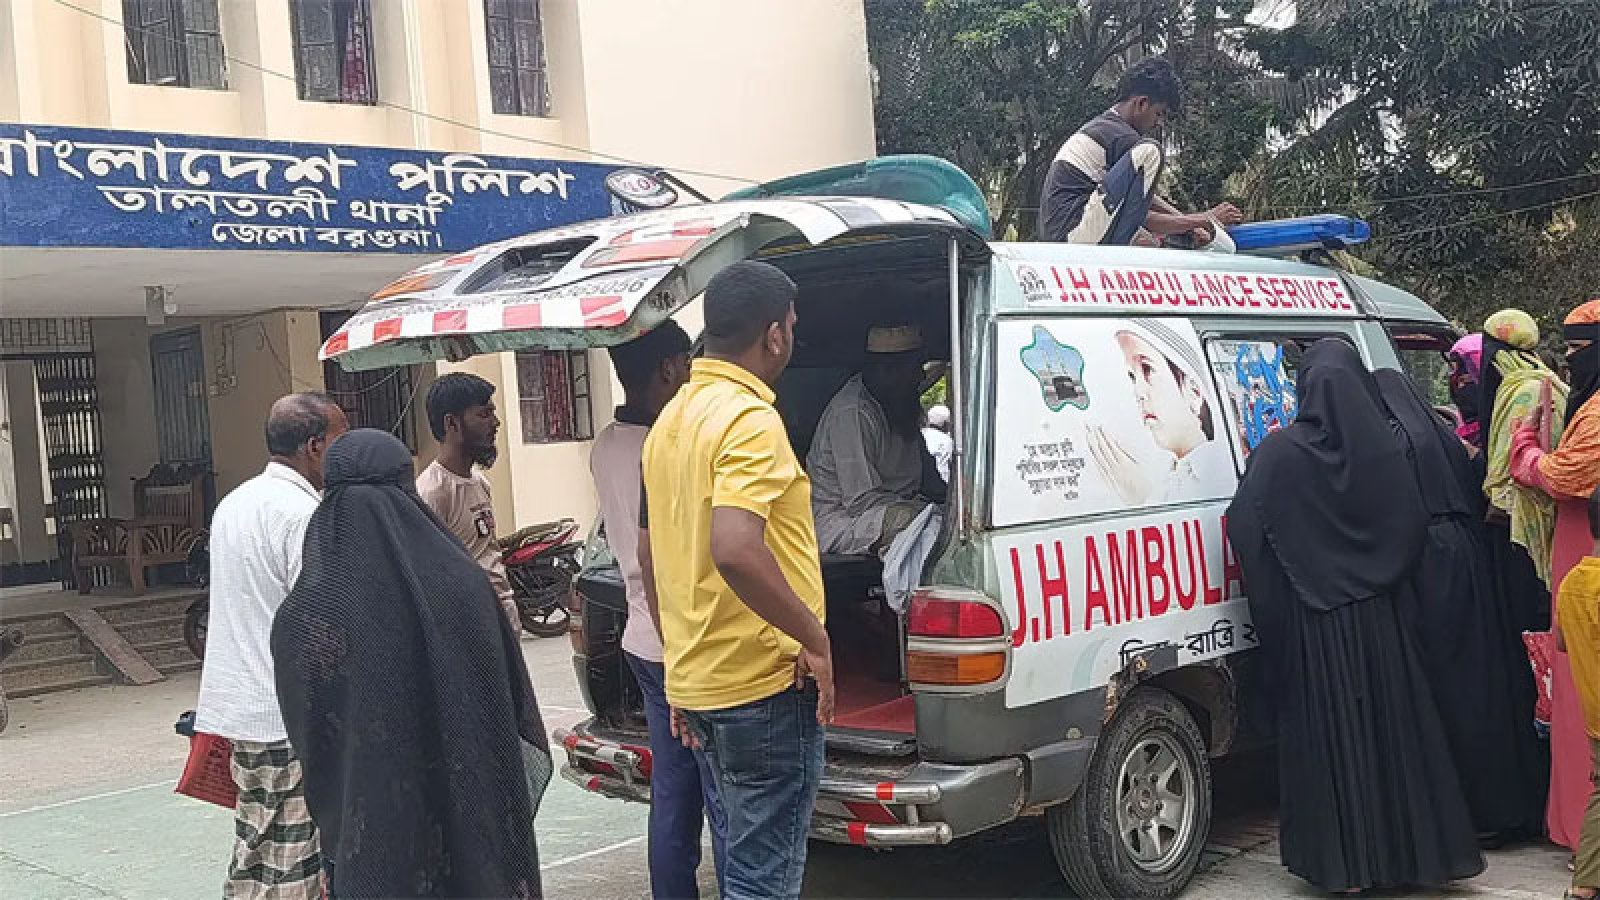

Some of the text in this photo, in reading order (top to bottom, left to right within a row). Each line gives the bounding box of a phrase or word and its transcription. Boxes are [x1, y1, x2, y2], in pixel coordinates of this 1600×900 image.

[389, 154, 576, 205] পুলিশ
[96, 184, 444, 227] তালতলী থানা
[211, 223, 310, 245] জেলা
[1099, 268, 1261, 308] AMBULANCE
[1256, 275, 1352, 310] SERVICE
[1010, 515, 1246, 649] J.H AMBULA
